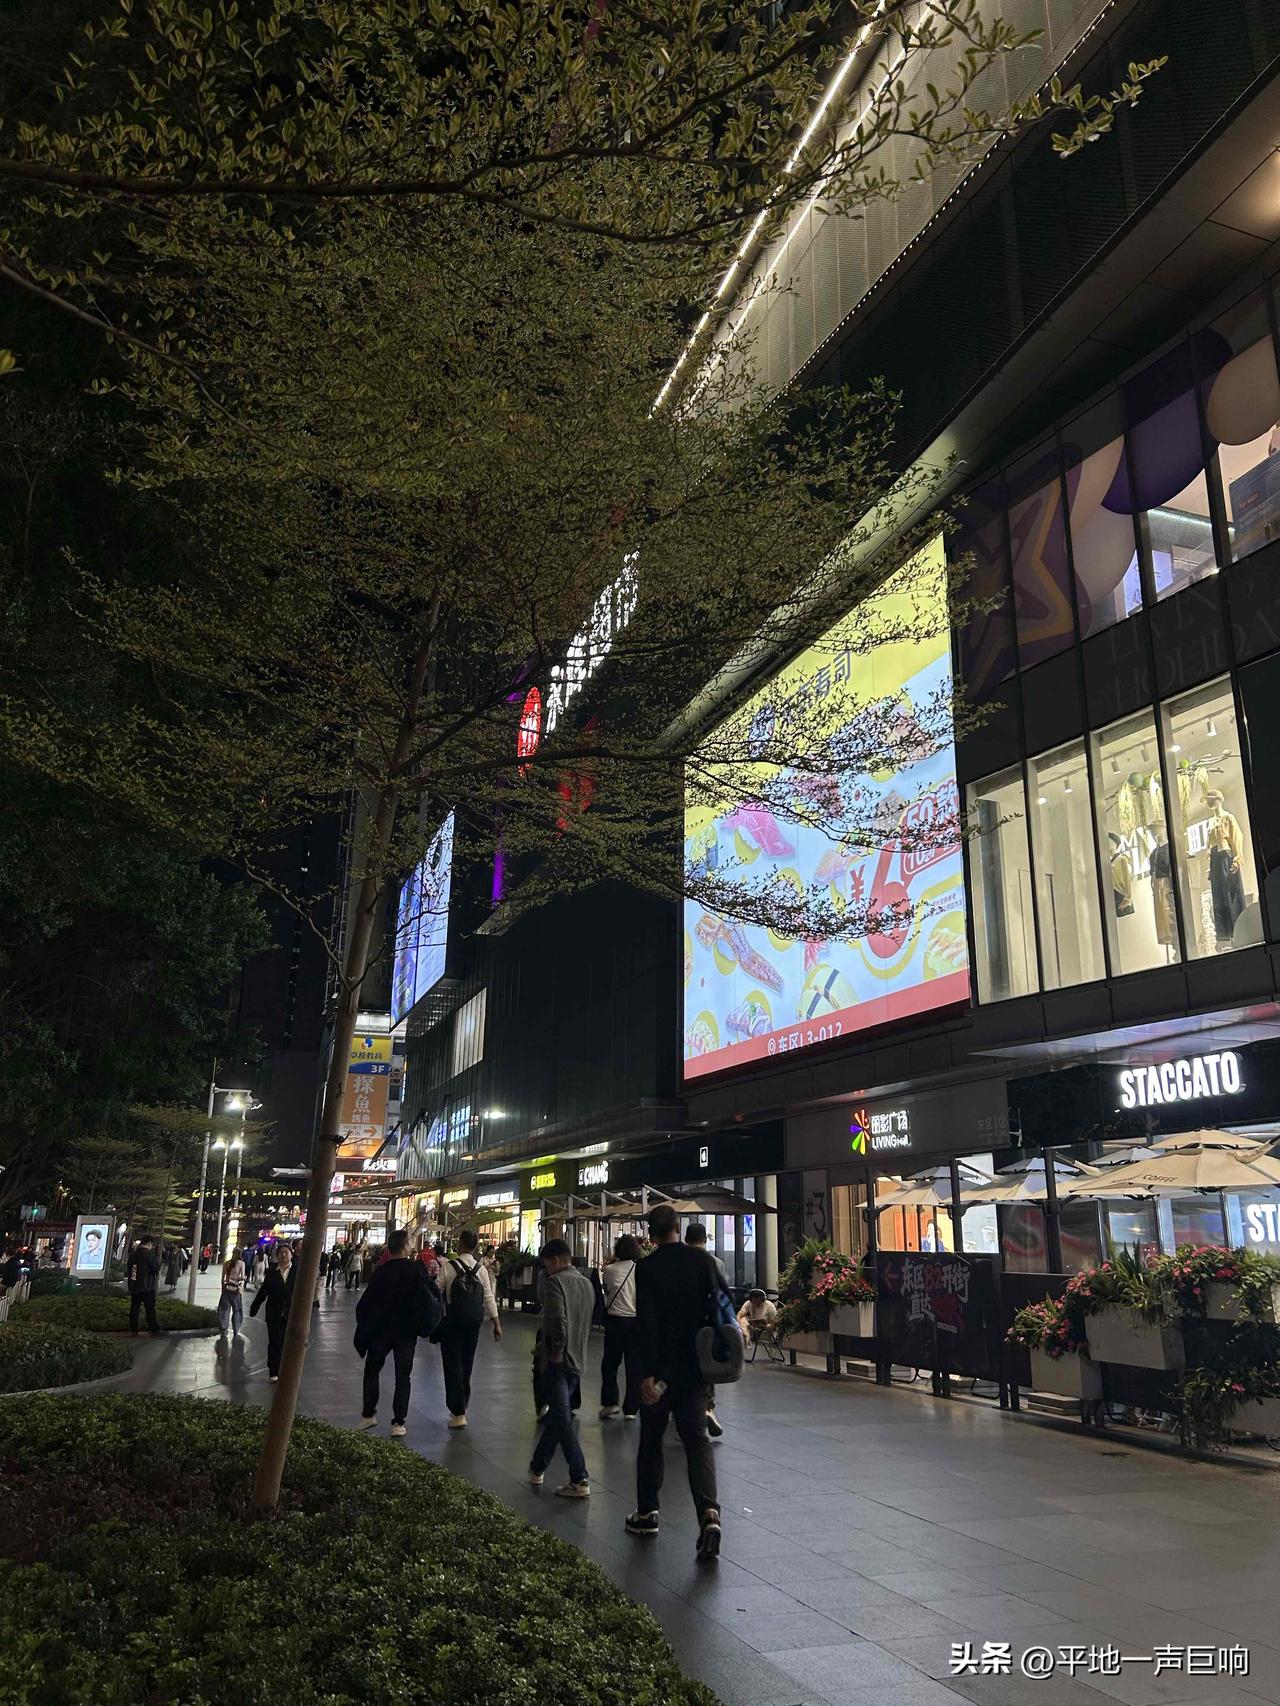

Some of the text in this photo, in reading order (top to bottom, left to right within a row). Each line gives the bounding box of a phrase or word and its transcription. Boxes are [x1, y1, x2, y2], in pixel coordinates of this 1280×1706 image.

[371, 1065, 385, 1073] 3F
[1119, 1051, 1241, 1109] STACCATO
[1142, 1174, 1179, 1183] COFFEE
